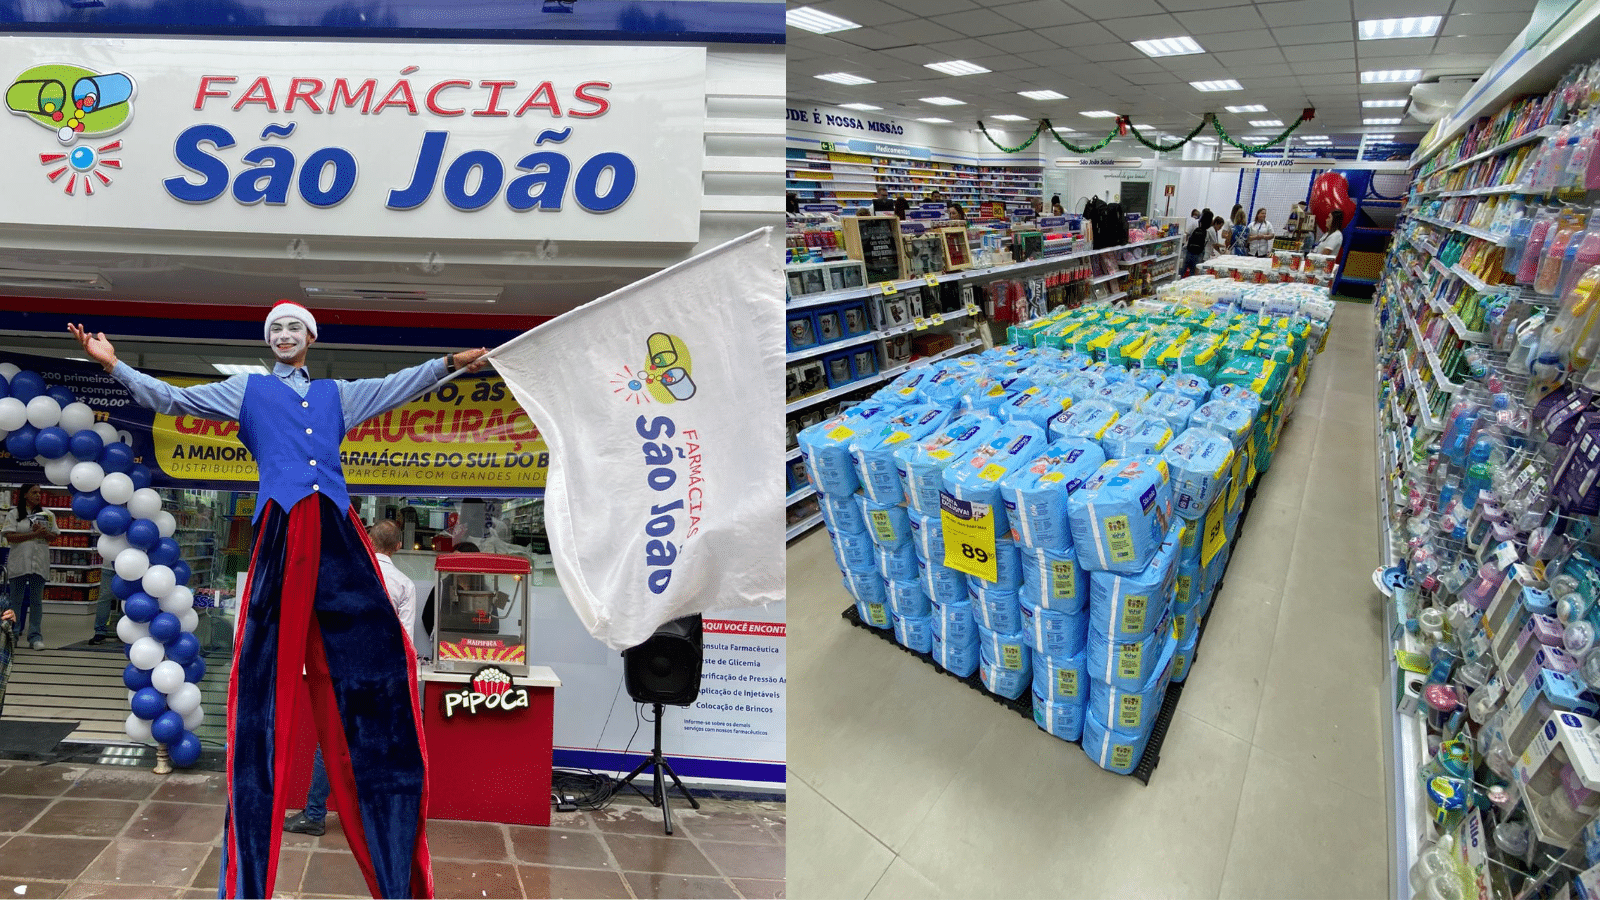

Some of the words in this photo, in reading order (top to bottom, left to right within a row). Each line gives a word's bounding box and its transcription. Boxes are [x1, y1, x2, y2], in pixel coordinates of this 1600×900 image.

[193, 65, 613, 118] FARMÁCIAS
[812, 108, 822, 125] É
[826, 114, 864, 130] NOSSA
[867, 121, 904, 135] MISSÃO
[875, 144, 911, 155] Medicamentos
[162, 122, 360, 208] São
[384, 126, 638, 213] João
[1256, 159, 1278, 167] Espaço
[41, 371, 62, 380] 200
[64, 373, 115, 384] primeiros
[81, 386, 129, 397] compras
[171, 444, 185, 459] A
[188, 445, 247, 461] MAIOR
[339, 448, 431, 467] ARMÁCIAS
[434, 452, 463, 467] DO
[465, 452, 501, 467] SUL
[504, 452, 534, 468] DO
[635, 415, 686, 491] São
[348, 468, 410, 478] PARCERIA
[415, 470, 445, 480] COM
[450, 471, 512, 481] GRANDES
[682, 429, 705, 539] FARMÁCIAS
[961, 543, 988, 563] 89
[702, 622, 722, 631] AQUI
[724, 622, 747, 632] VOCÊ
[749, 624, 786, 634] ENCONT
[730, 644, 779, 653] Farmacêutica
[728, 658, 761, 667] Glicemia
[701, 673, 737, 682] erificação
[738, 674, 748, 682] de
[749, 675, 778, 683] Pressão
[744, 689, 780, 699] Injetáveis
[696, 702, 733, 711] Colocação
[745, 704, 773, 713] Brincos
